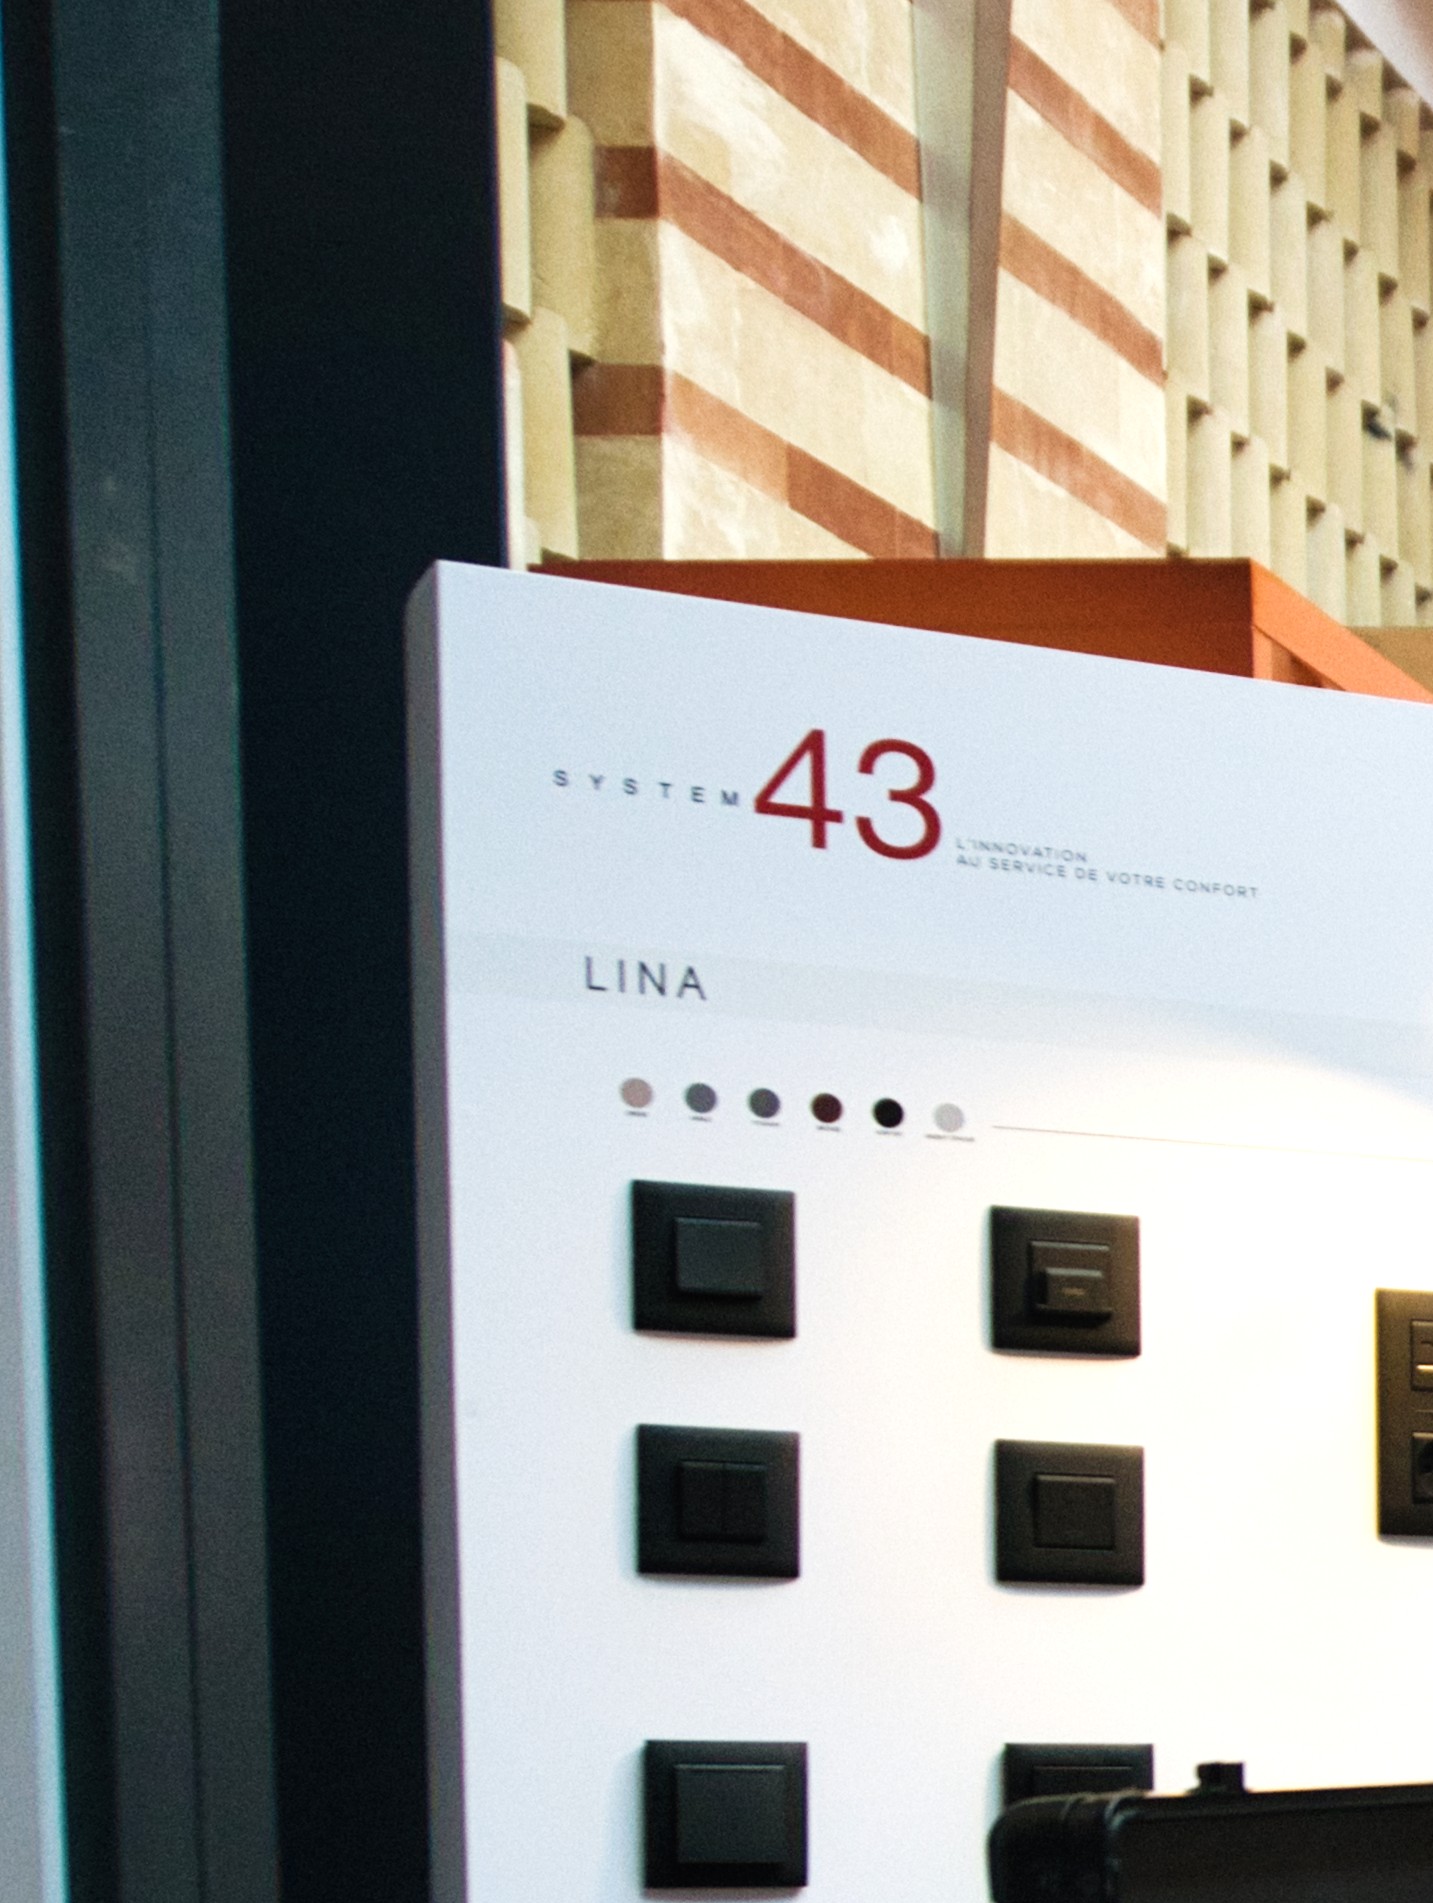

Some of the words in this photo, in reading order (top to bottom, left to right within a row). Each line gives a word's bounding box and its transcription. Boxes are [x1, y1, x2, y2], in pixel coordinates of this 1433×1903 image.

[552, 769, 740, 807] SYSTEM
[754, 728, 942, 860] 43
[956, 837, 1088, 863] L'INNOVATION
[956, 854, 980, 868] AU
[989, 857, 1067, 878] SERVICE
[1075, 867, 1098, 881] DE
[1107, 871, 1166, 888] VOTRE
[1173, 878, 1259, 898] CONFORT
[584, 956, 707, 1001] LINA
